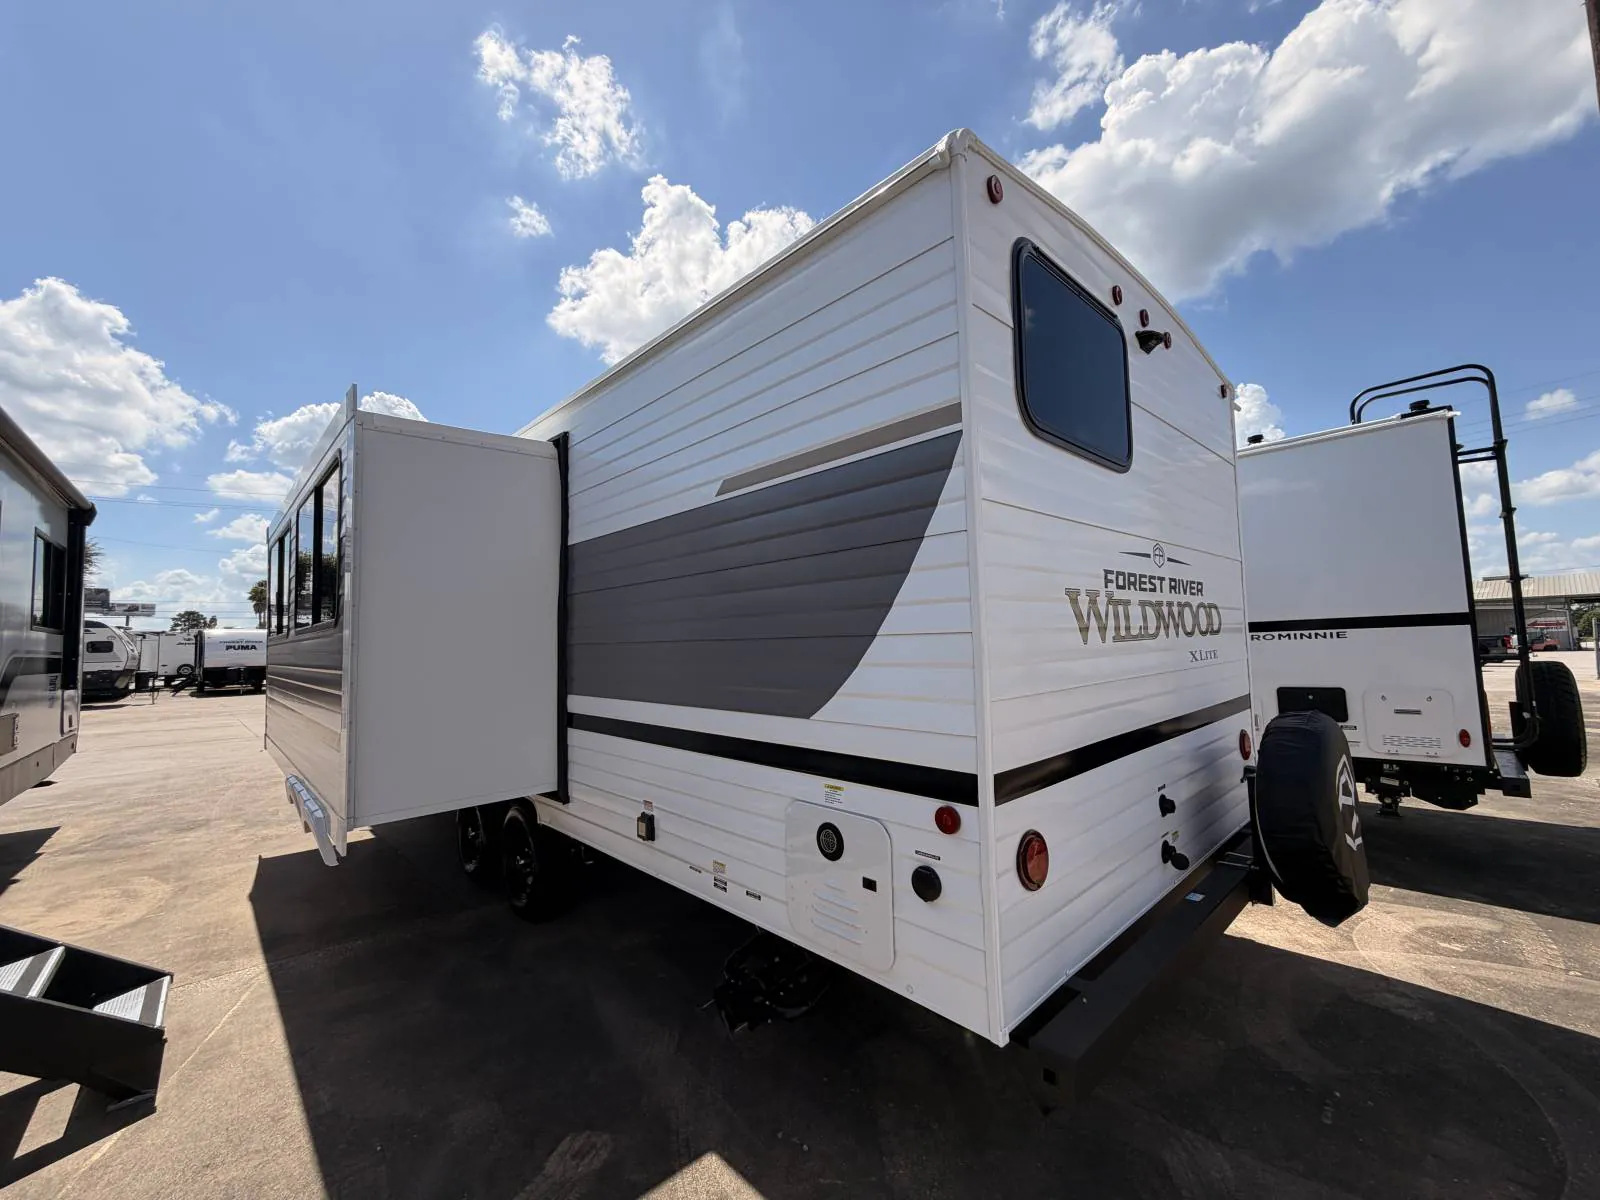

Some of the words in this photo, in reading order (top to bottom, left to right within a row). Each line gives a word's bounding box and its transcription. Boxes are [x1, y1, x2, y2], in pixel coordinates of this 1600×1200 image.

[1103, 569, 1166, 593] FOREST
[1169, 577, 1204, 597] RIVER
[1065, 588, 1222, 645] WILDWOOD
